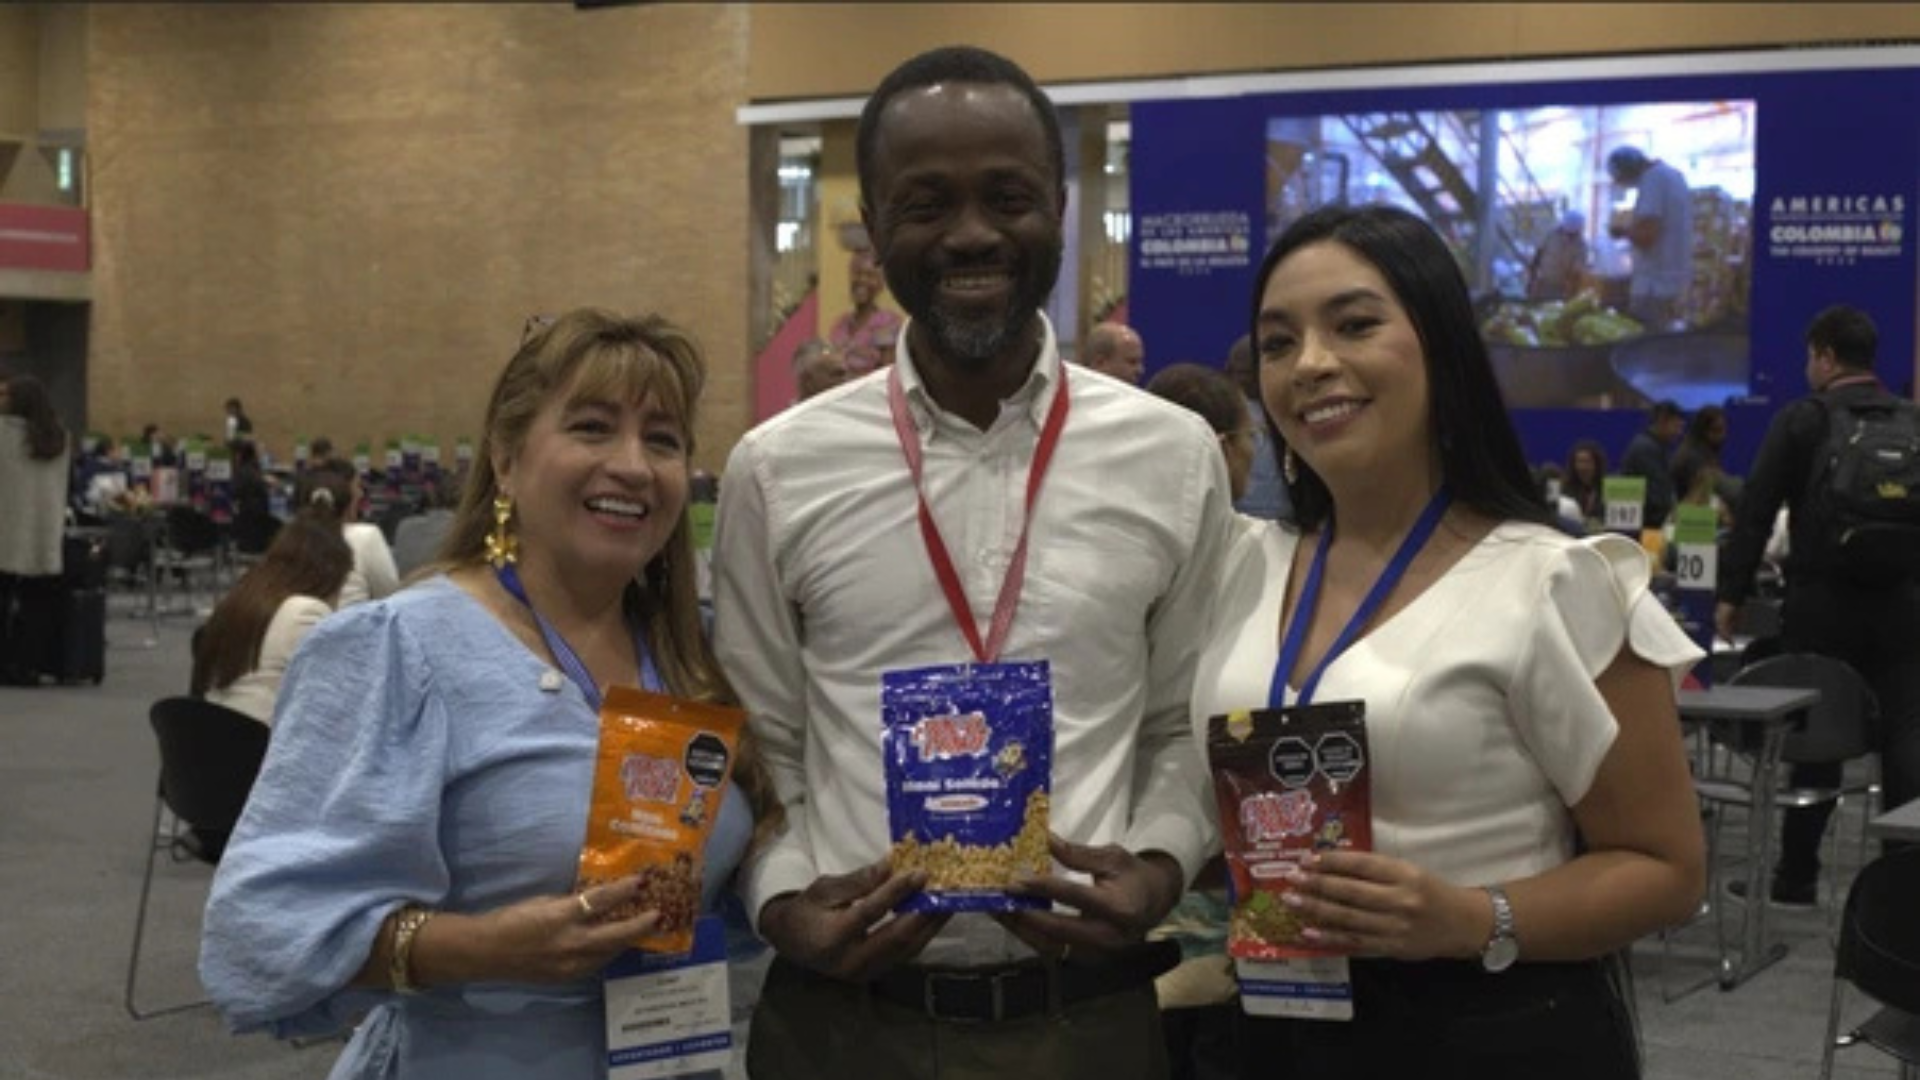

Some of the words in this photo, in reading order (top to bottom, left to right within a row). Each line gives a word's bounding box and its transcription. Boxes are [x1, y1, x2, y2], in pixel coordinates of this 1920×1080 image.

[1772, 195, 1905, 212] AMERICAS
[1770, 225, 1876, 243] COLOMBIA
[1141, 238, 1227, 254] COLOMBIA
